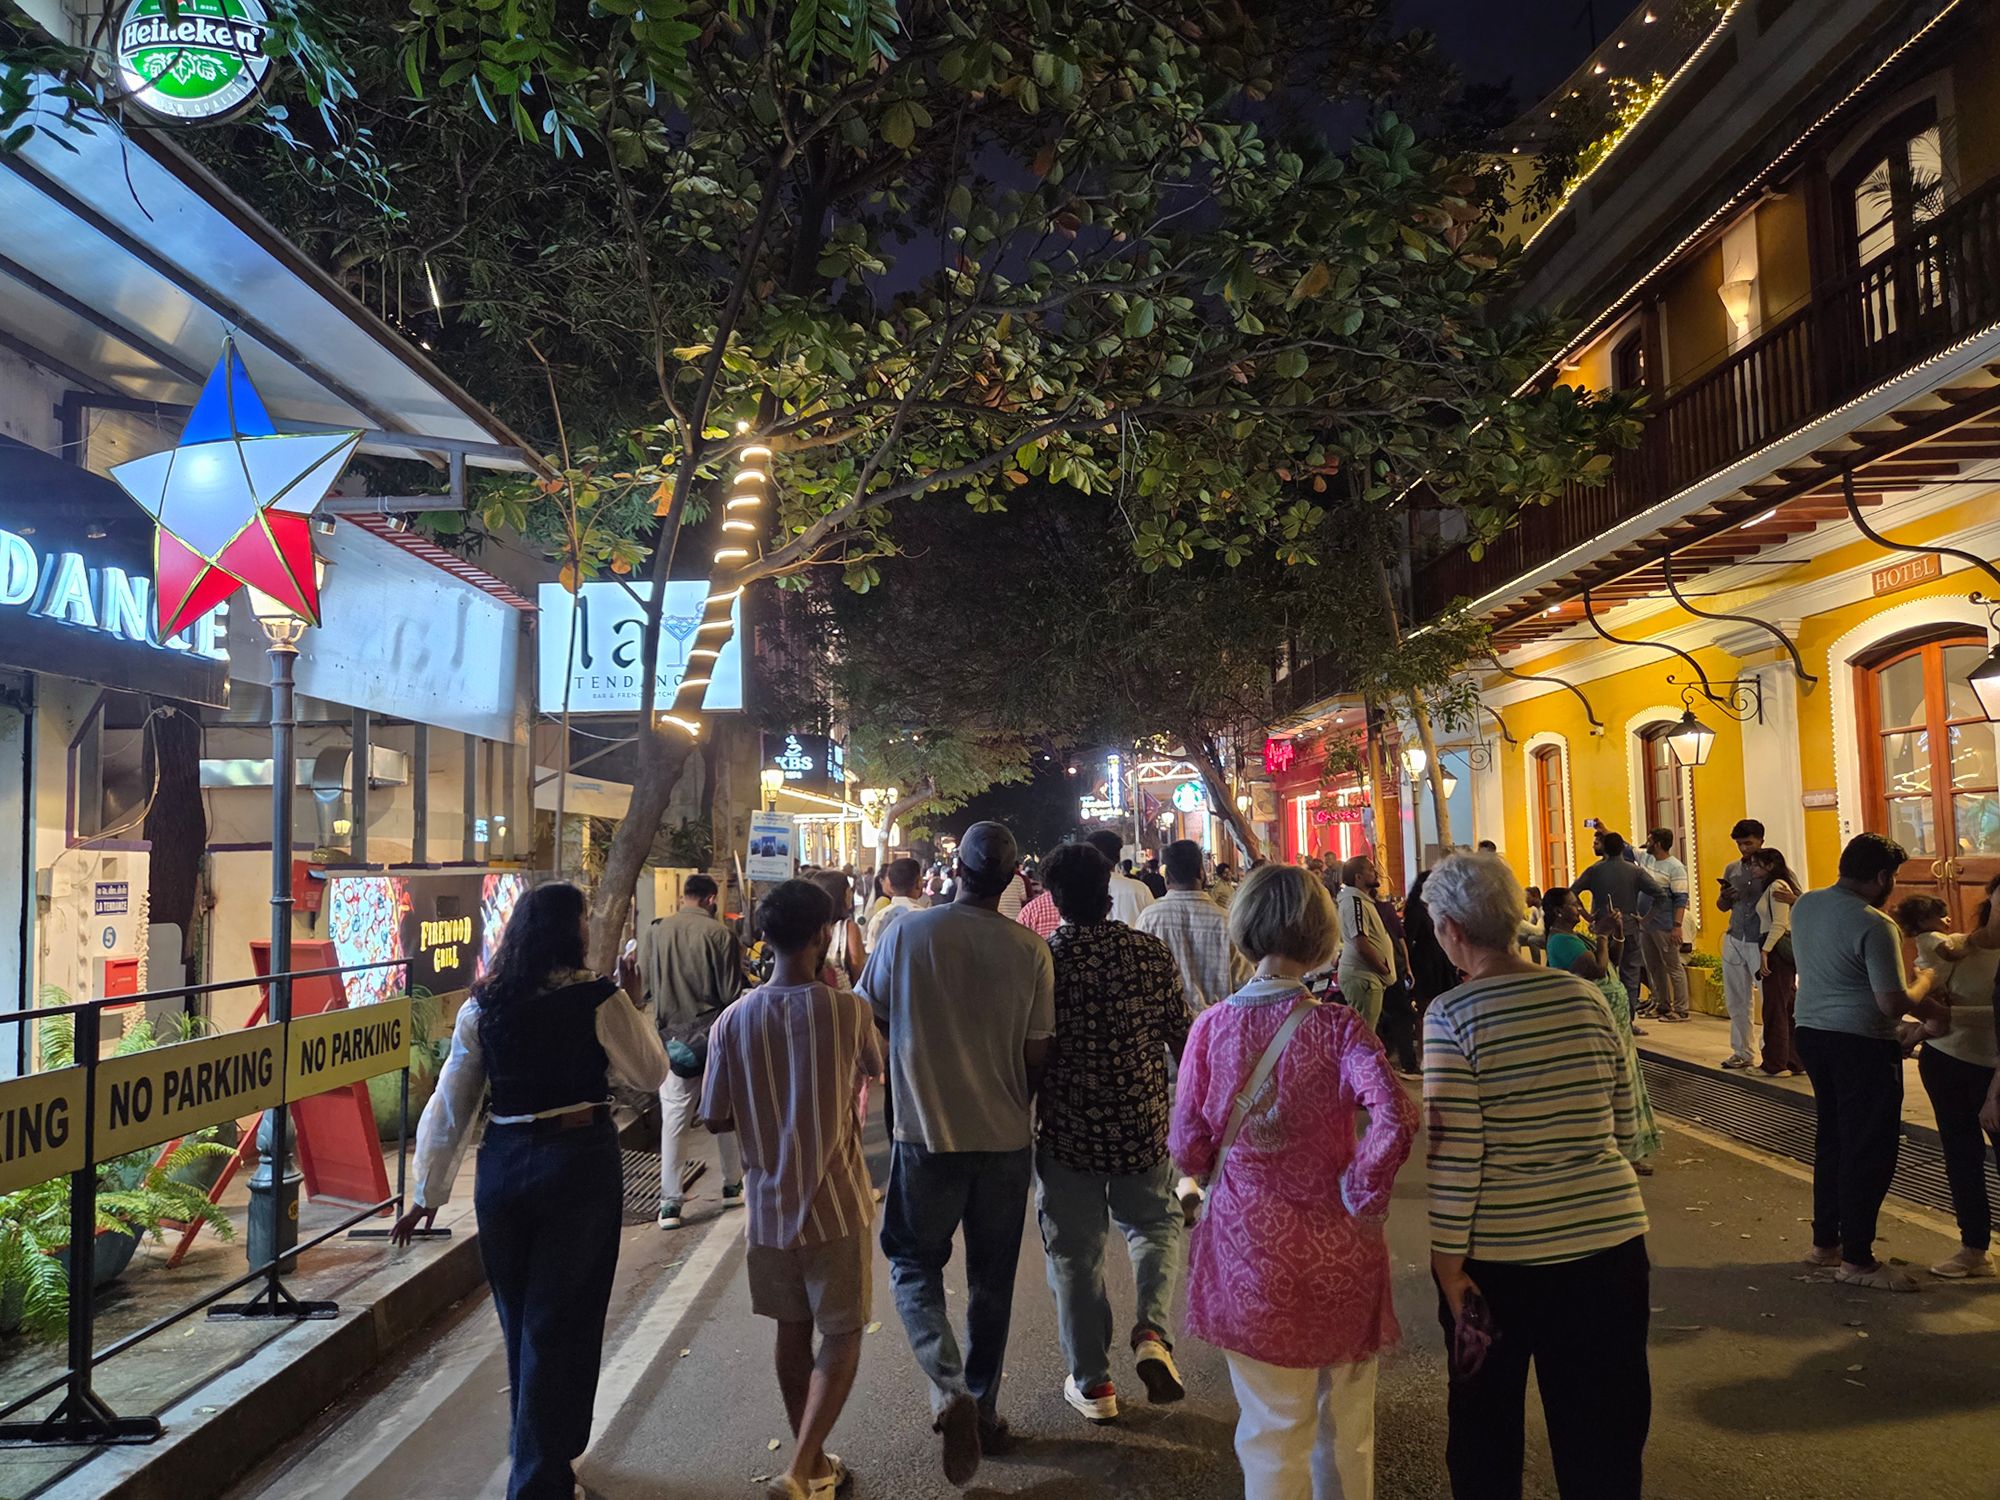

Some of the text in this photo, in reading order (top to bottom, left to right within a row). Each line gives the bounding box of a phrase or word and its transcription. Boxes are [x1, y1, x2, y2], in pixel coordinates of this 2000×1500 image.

[1875, 557, 1935, 592] HOTEL
[0, 528, 231, 661] DANE
[574, 674, 685, 690] TENDNC
[774, 756, 814, 771] KBS
[105, 927, 114, 946] 5
[420, 916, 472, 952] FIREWOOD
[433, 945, 460, 973] GRILL
[300, 1018, 402, 1076] NO PARKING
[109, 1047, 274, 1131] NO PARKING
[0, 1097, 70, 1163] ING
